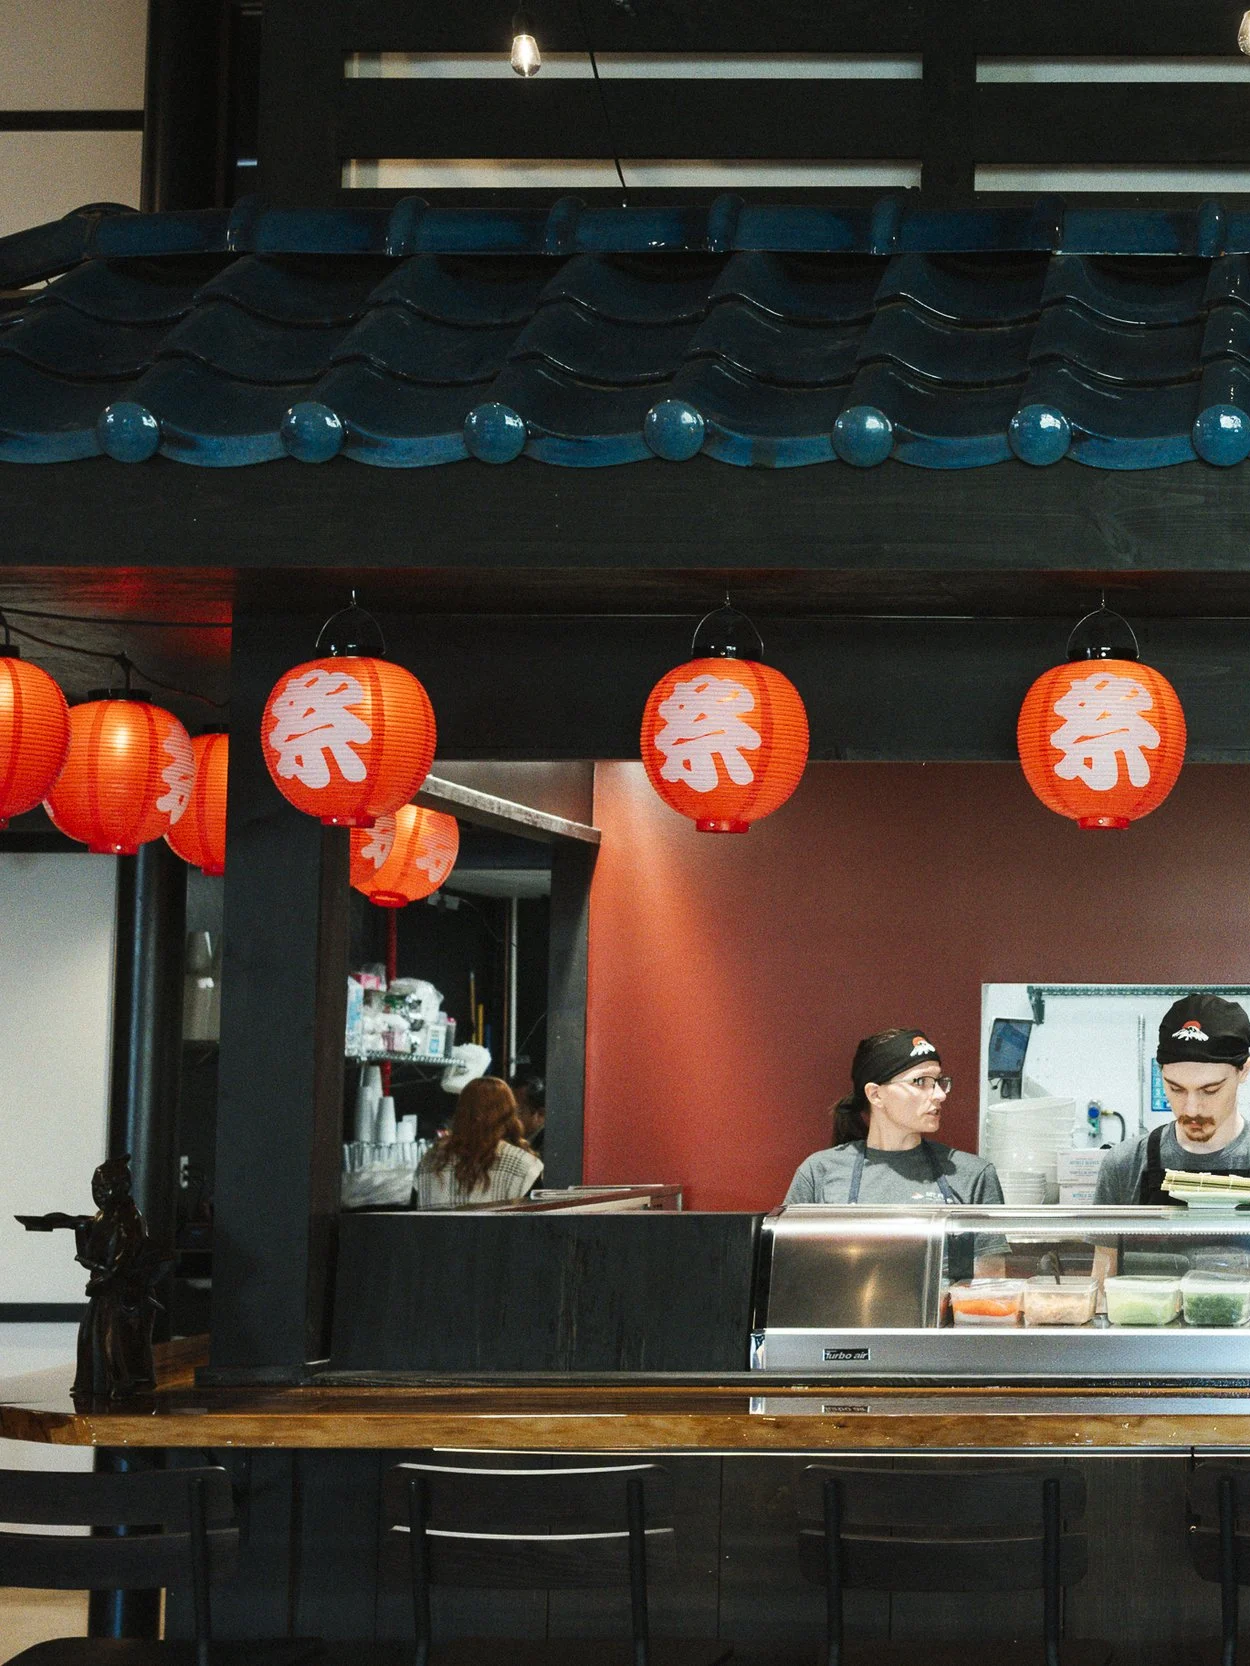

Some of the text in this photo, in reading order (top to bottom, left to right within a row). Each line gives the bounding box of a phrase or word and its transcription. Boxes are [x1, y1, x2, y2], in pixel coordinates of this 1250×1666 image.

[270, 669, 373, 789] 祭
[654, 674, 762, 793] 祭
[1050, 672, 1161, 792] 祭
[825, 1350, 868, 1360] Turbo air
